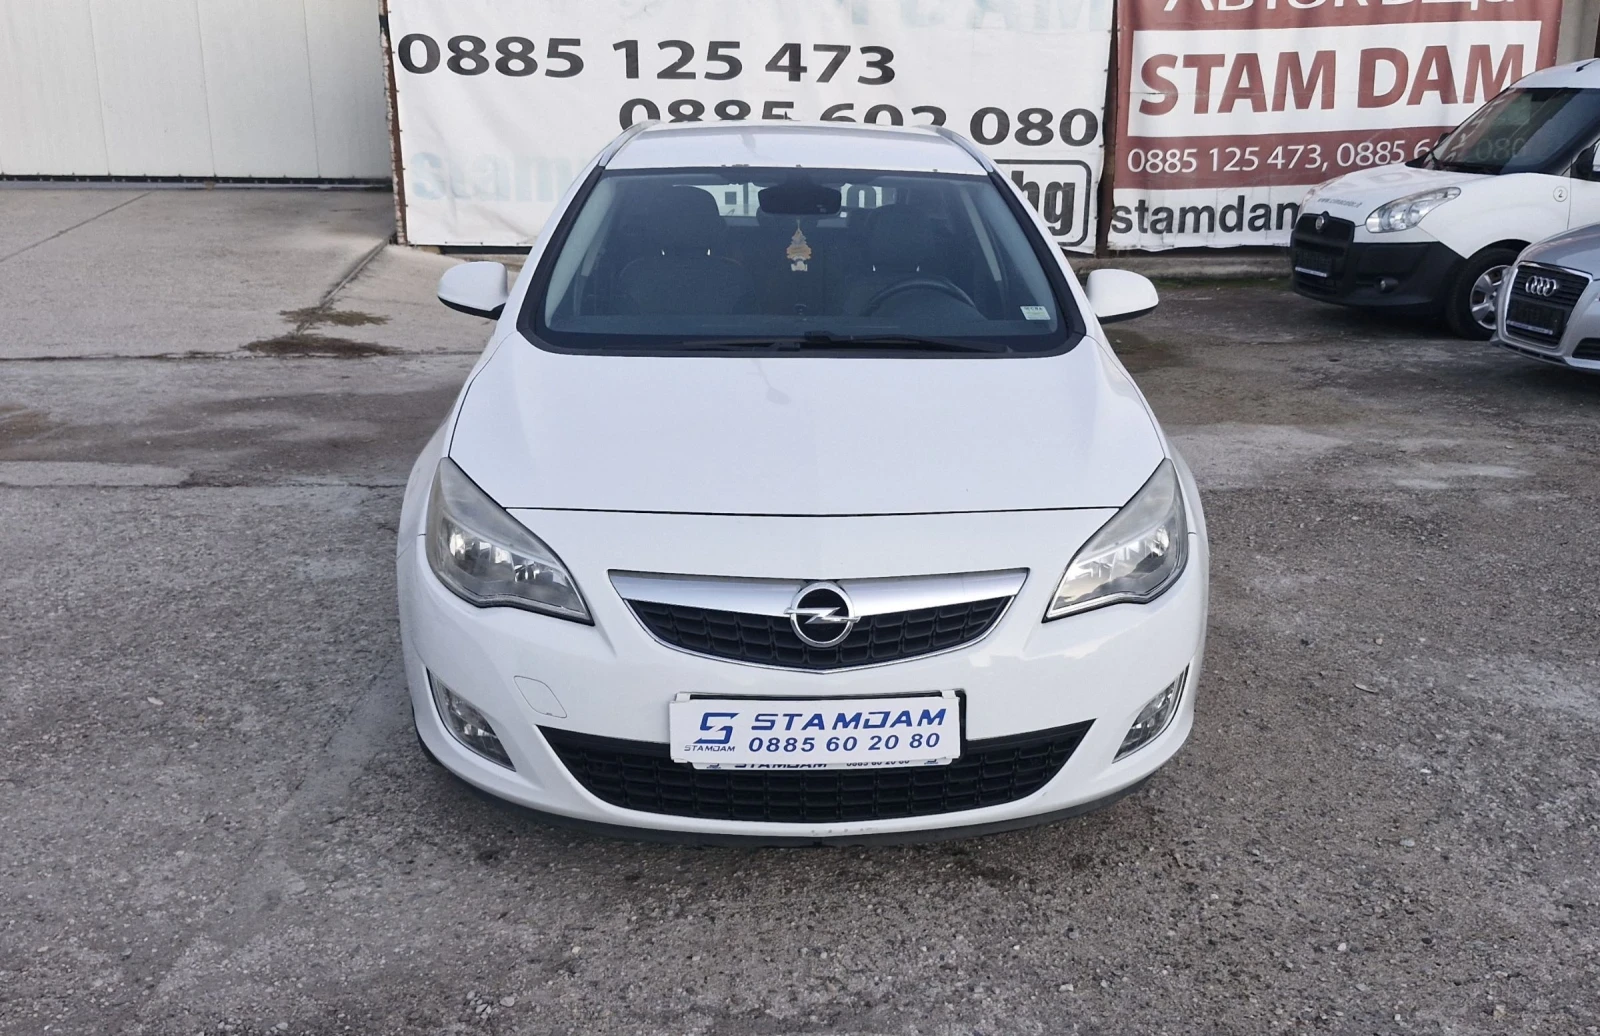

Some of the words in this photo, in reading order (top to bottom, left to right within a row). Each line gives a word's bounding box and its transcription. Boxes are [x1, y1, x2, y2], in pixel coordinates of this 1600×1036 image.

[397, 33, 584, 78] 0885
[612, 39, 743, 80] 125
[765, 42, 895, 85] 473
[1138, 50, 1336, 116] STAM
[1356, 44, 1525, 109] DAM
[970, 106, 1098, 147] 080
[1127, 148, 1197, 174] 0885
[1209, 146, 1259, 171] 125
[1267, 144, 1328, 172] 473,
[1336, 139, 1405, 168] 0885
[751, 708, 947, 731] STAMDAM
[683, 744, 736, 752] STAMDAM
[748, 736, 815, 752] 0885
[826, 736, 858, 752] 60
[868, 734, 900, 751] 20
[909, 732, 940, 749] 80
